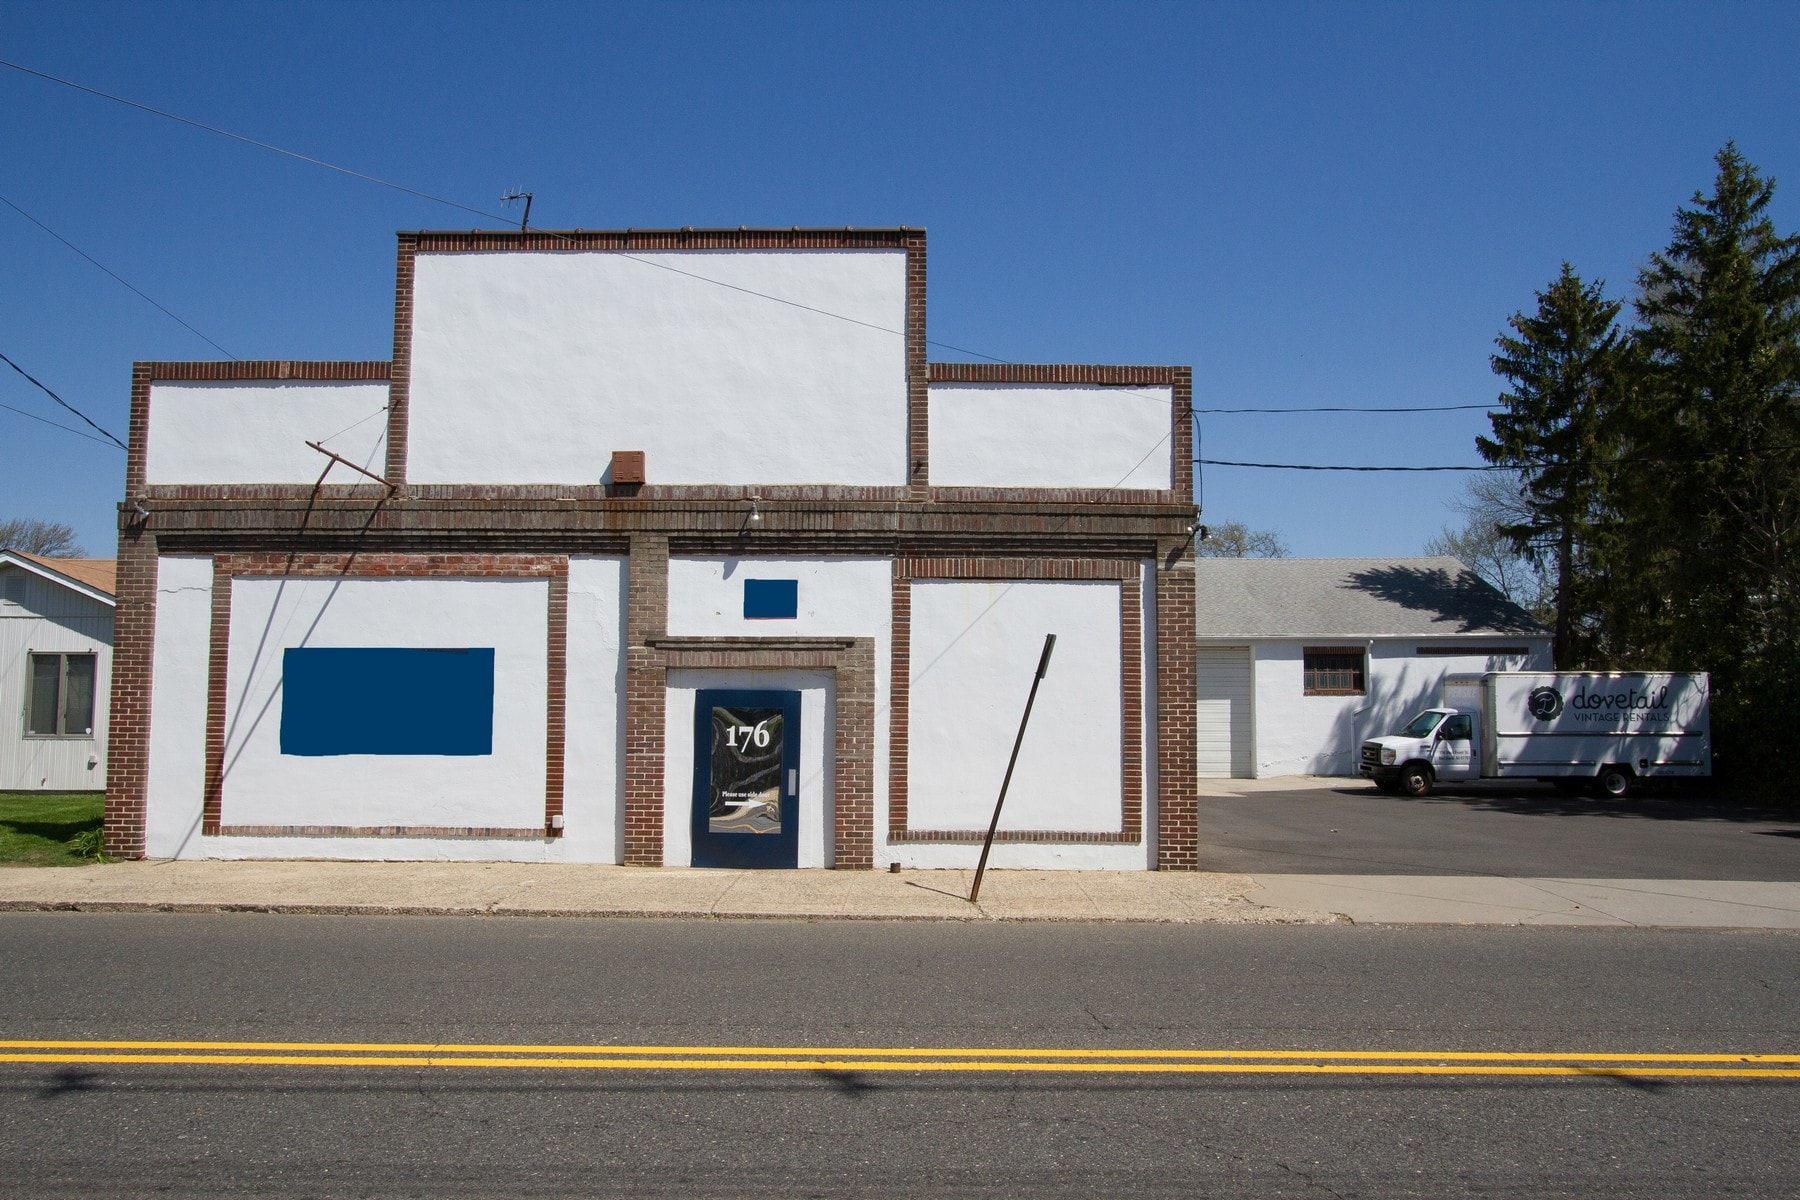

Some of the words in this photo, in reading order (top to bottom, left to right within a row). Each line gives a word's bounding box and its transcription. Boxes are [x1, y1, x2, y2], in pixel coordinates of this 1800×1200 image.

[1572, 685, 1668, 710] dovetail
[1573, 712, 1619, 722] VINTAGE
[1623, 712, 1669, 722] RENTALS
[726, 720, 770, 753] 176
[722, 790, 738, 798] Please
